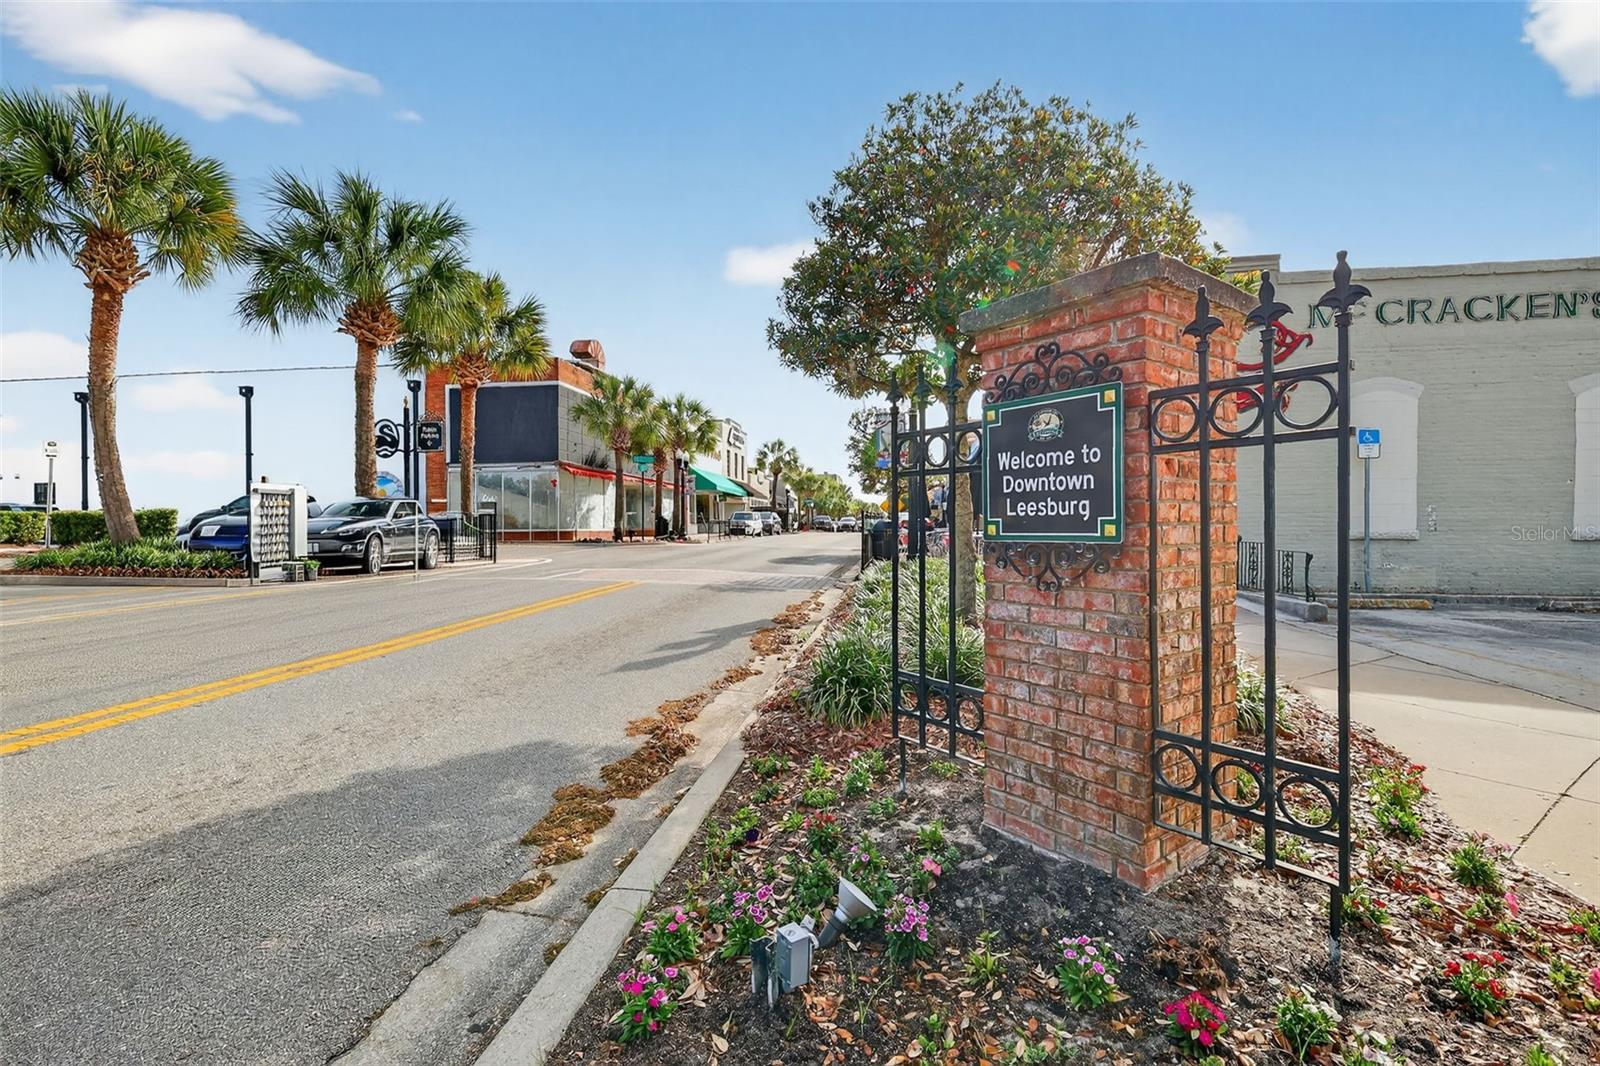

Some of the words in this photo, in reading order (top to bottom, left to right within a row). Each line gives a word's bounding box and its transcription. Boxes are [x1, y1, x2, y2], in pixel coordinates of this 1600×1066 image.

[998, 449, 1075, 471] Welcome
[1081, 444, 1101, 463] to
[1002, 472, 1095, 493] Downtown
[1006, 497, 1090, 521] Leesburg
